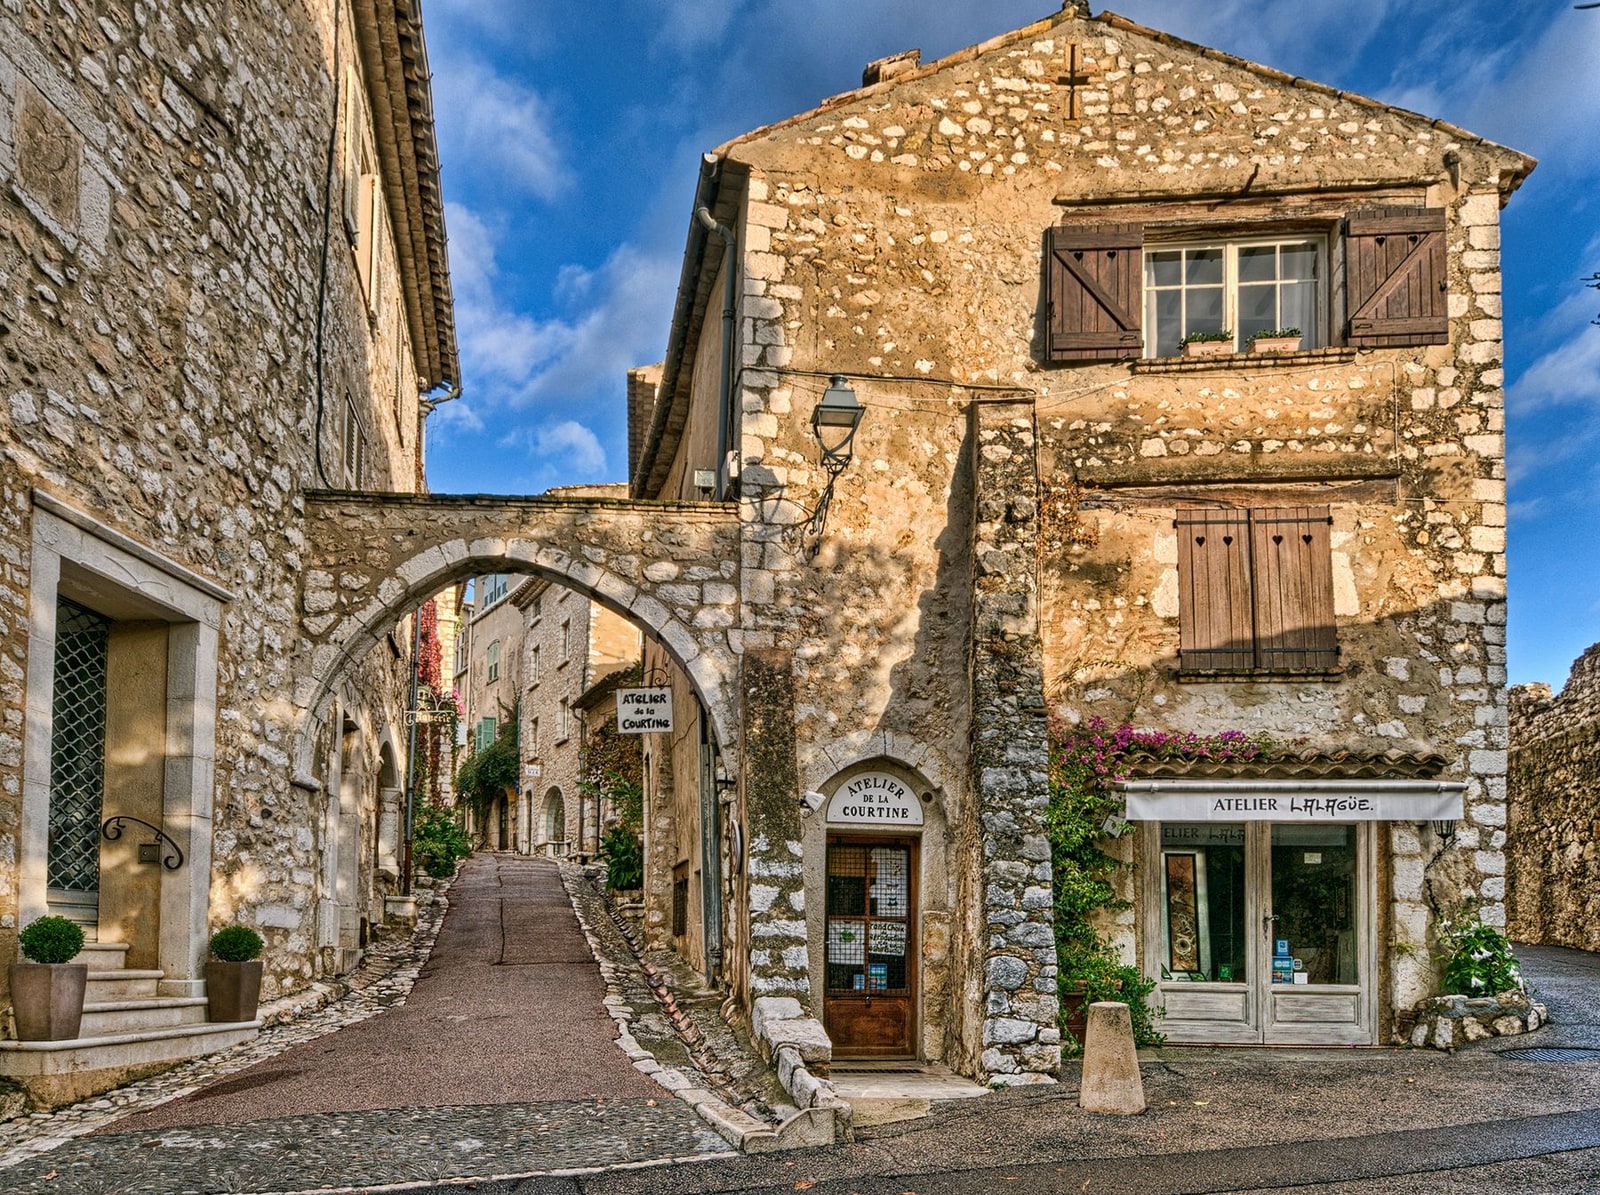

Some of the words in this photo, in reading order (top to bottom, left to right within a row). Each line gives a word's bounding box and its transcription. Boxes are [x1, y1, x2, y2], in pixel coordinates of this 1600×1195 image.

[634, 707, 644, 715] de
[646, 707, 655, 715] la
[847, 777, 905, 800] ATELIER
[863, 794, 874, 803] DE
[878, 795, 889, 804] LA
[1213, 798, 1278, 811] ATELIER
[842, 806, 909, 818] COURTINE
